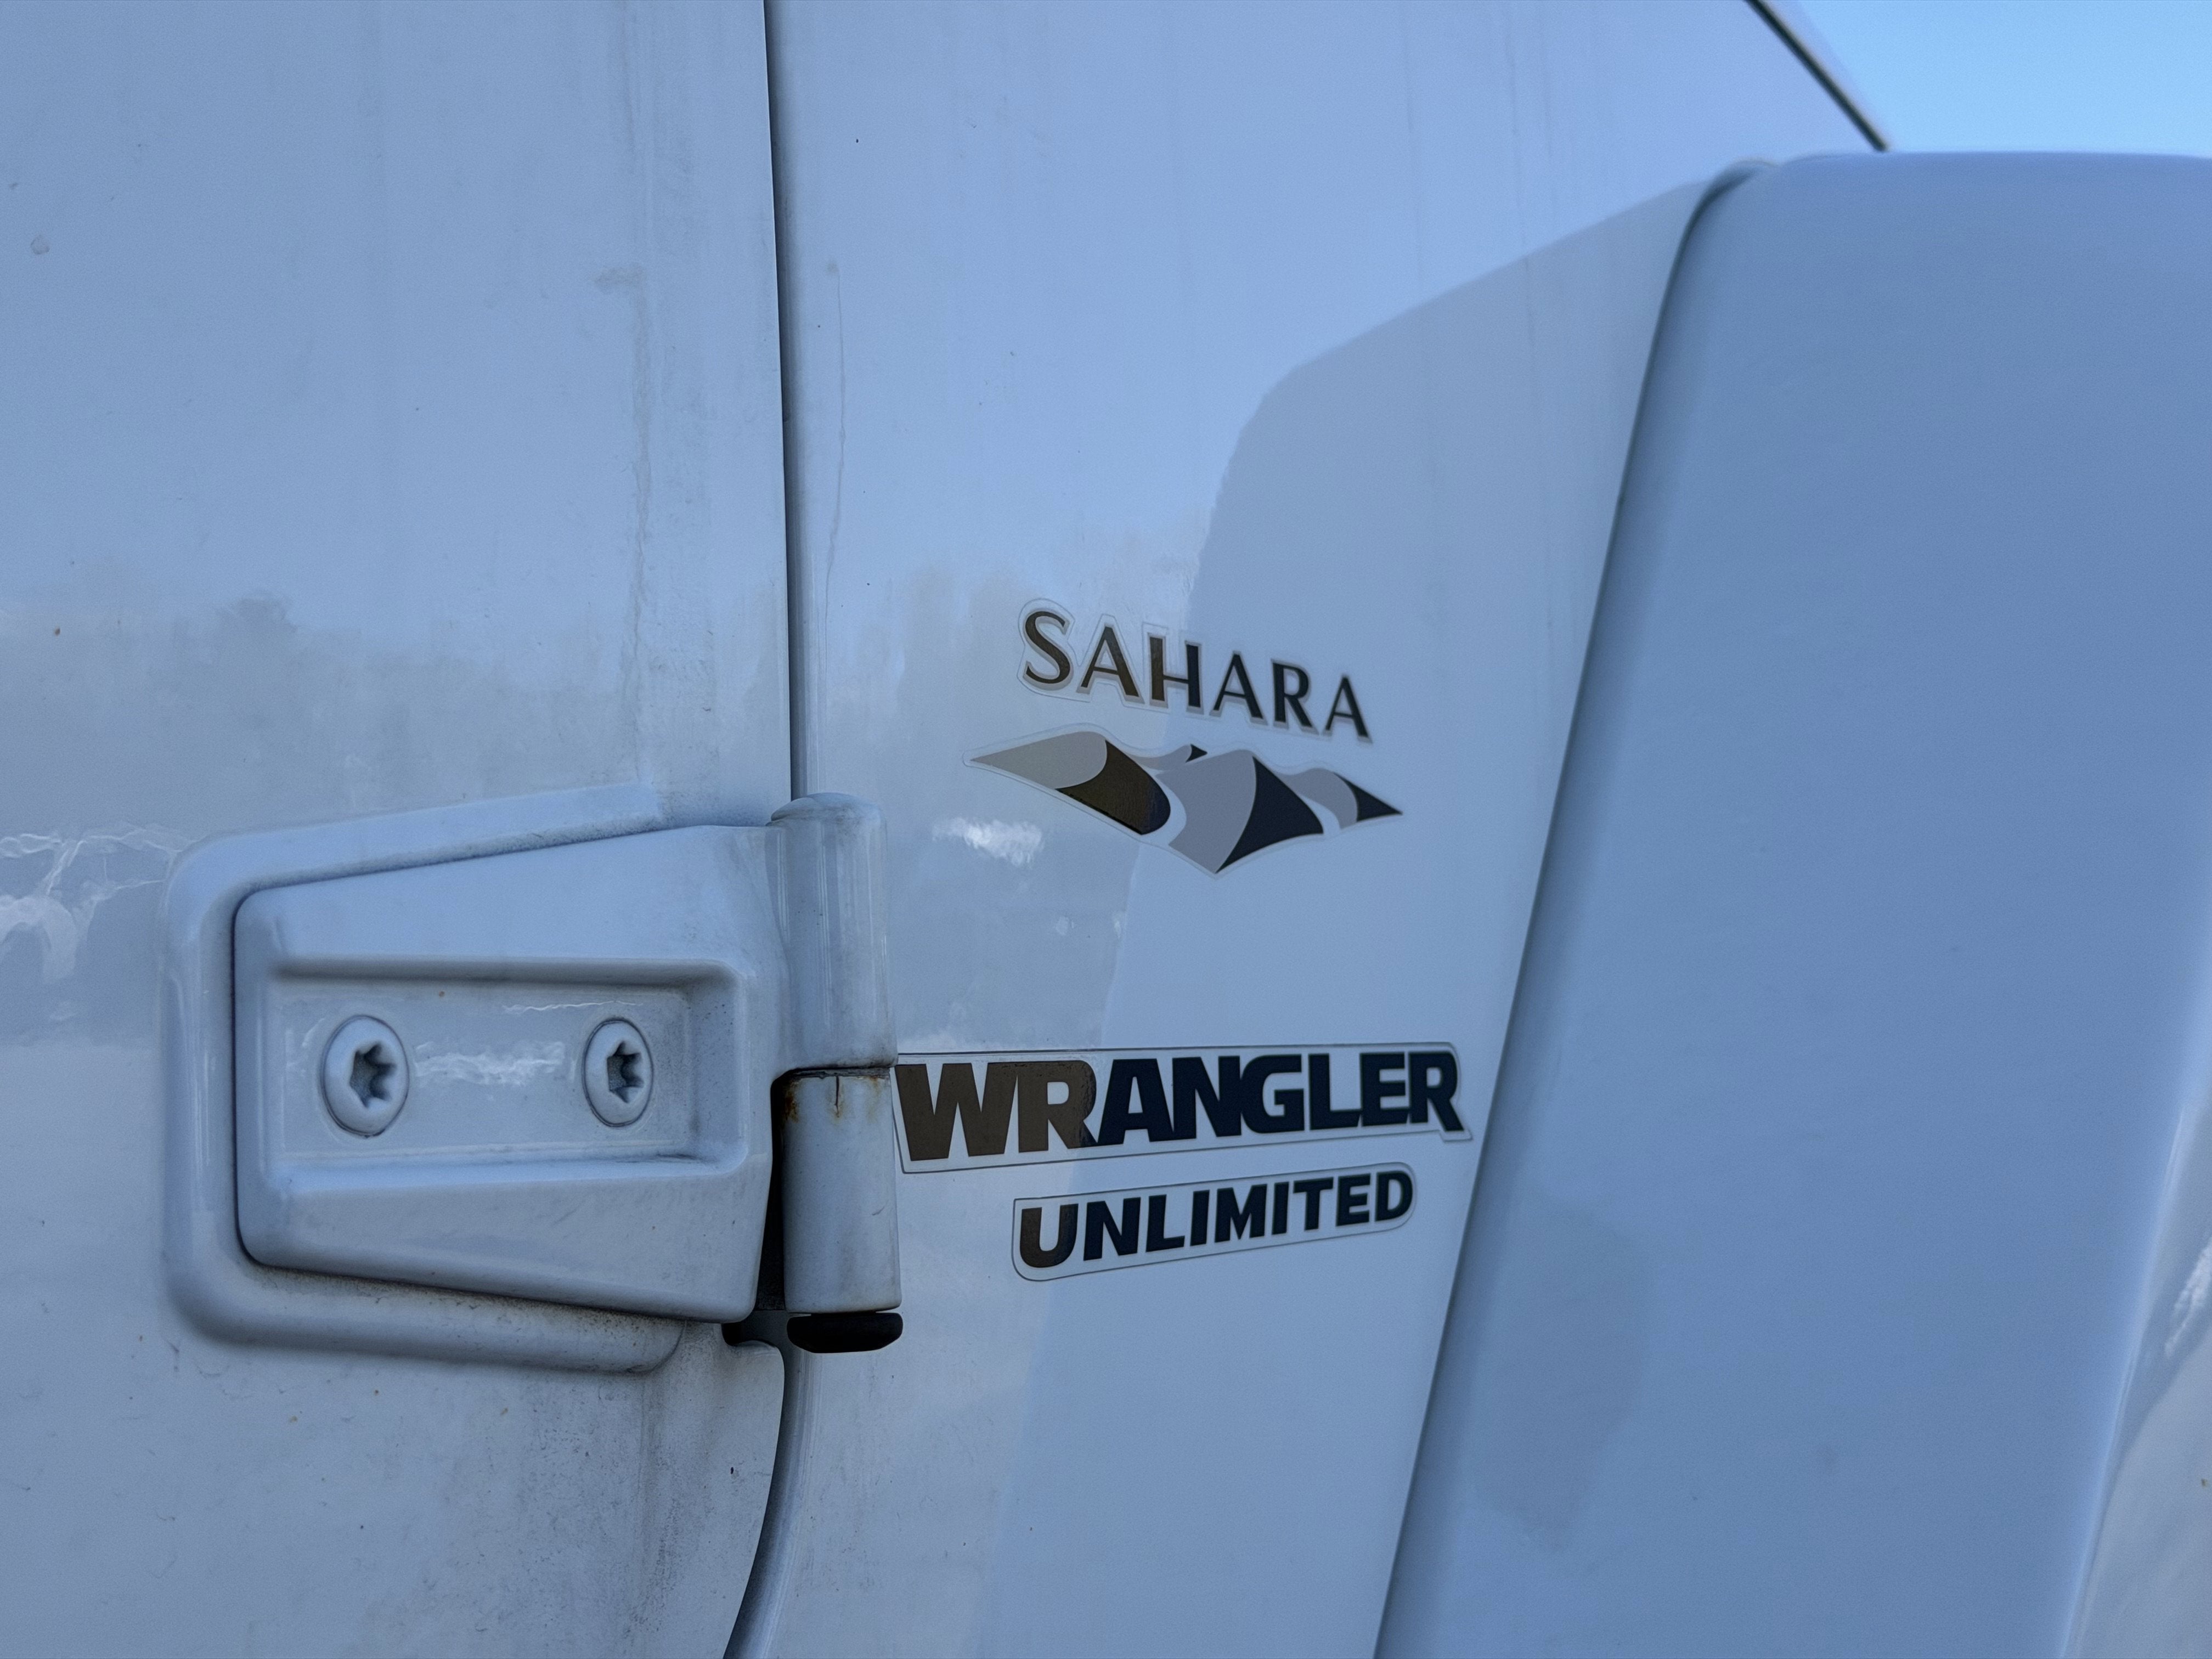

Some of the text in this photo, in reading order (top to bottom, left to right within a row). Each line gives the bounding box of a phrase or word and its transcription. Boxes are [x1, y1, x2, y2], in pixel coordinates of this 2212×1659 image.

[1022, 609, 1372, 742] SAHARA
[894, 1051, 1464, 1161] WRANGLER
[1019, 1170, 1413, 1268] UNLIMITED
